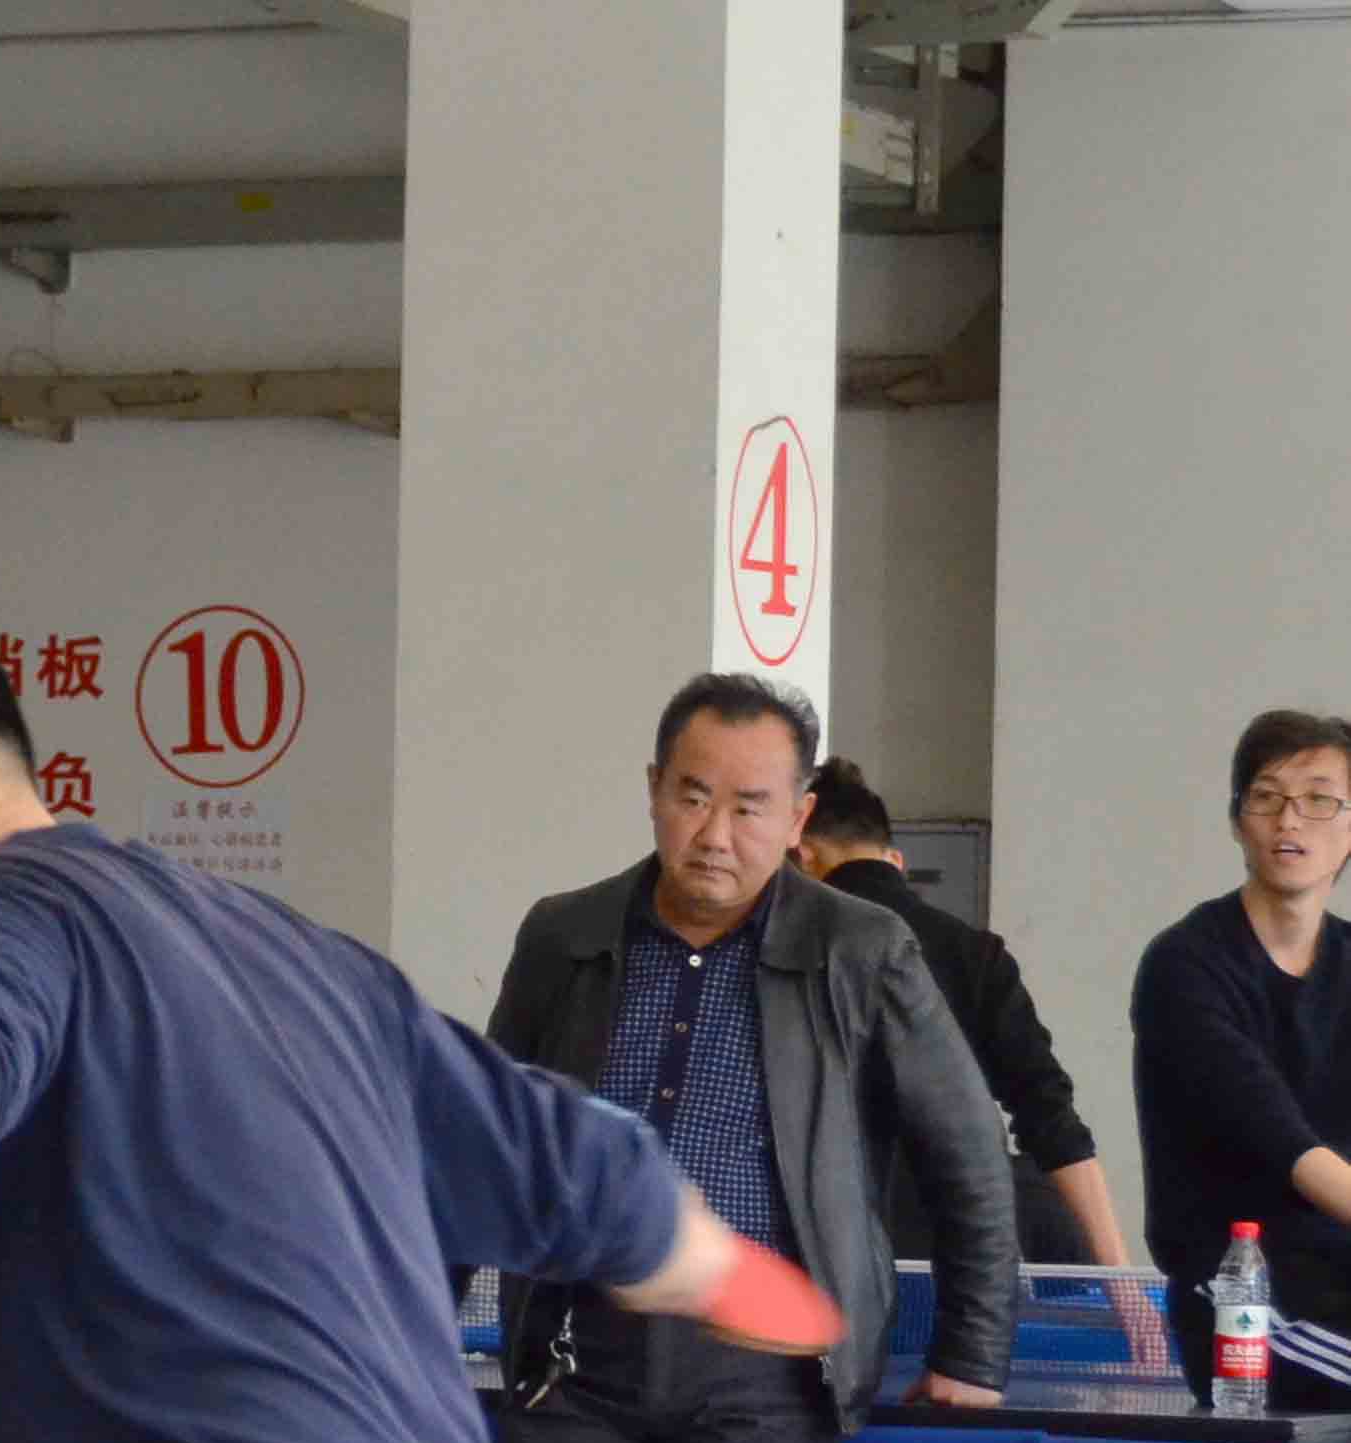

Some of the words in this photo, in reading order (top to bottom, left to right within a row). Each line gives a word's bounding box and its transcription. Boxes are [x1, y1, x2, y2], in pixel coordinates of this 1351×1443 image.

[739, 441, 799, 617] 4
[167, 628, 284, 755] 10
[37, 751, 97, 818] 负
